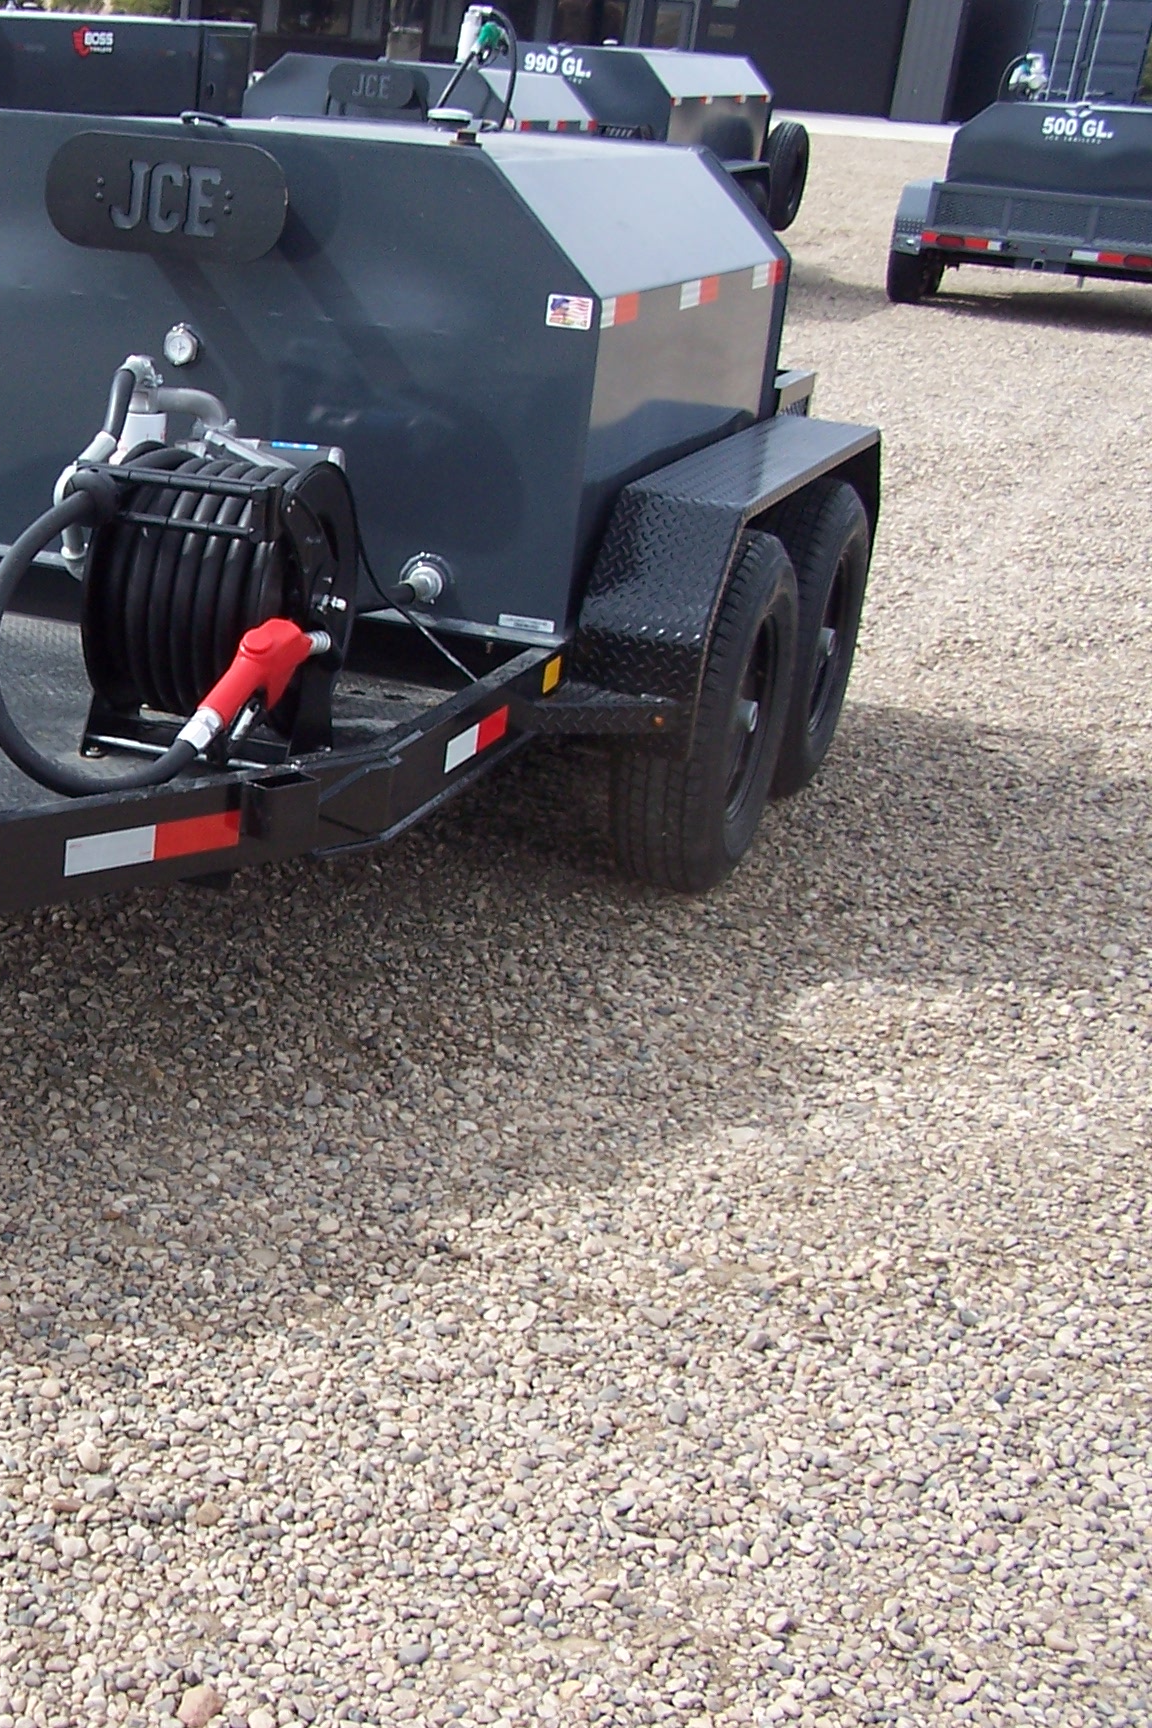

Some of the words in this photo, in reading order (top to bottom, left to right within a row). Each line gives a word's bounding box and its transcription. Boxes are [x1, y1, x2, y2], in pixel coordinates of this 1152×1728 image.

[84, 31, 114, 46] BOSS
[524, 52, 558, 74] 990
[561, 57, 592, 78] GL.
[351, 73, 391, 99] JCE
[1042, 116, 1078, 135] 500
[1082, 119, 1114, 139] GL.
[109, 160, 222, 238] JCE
